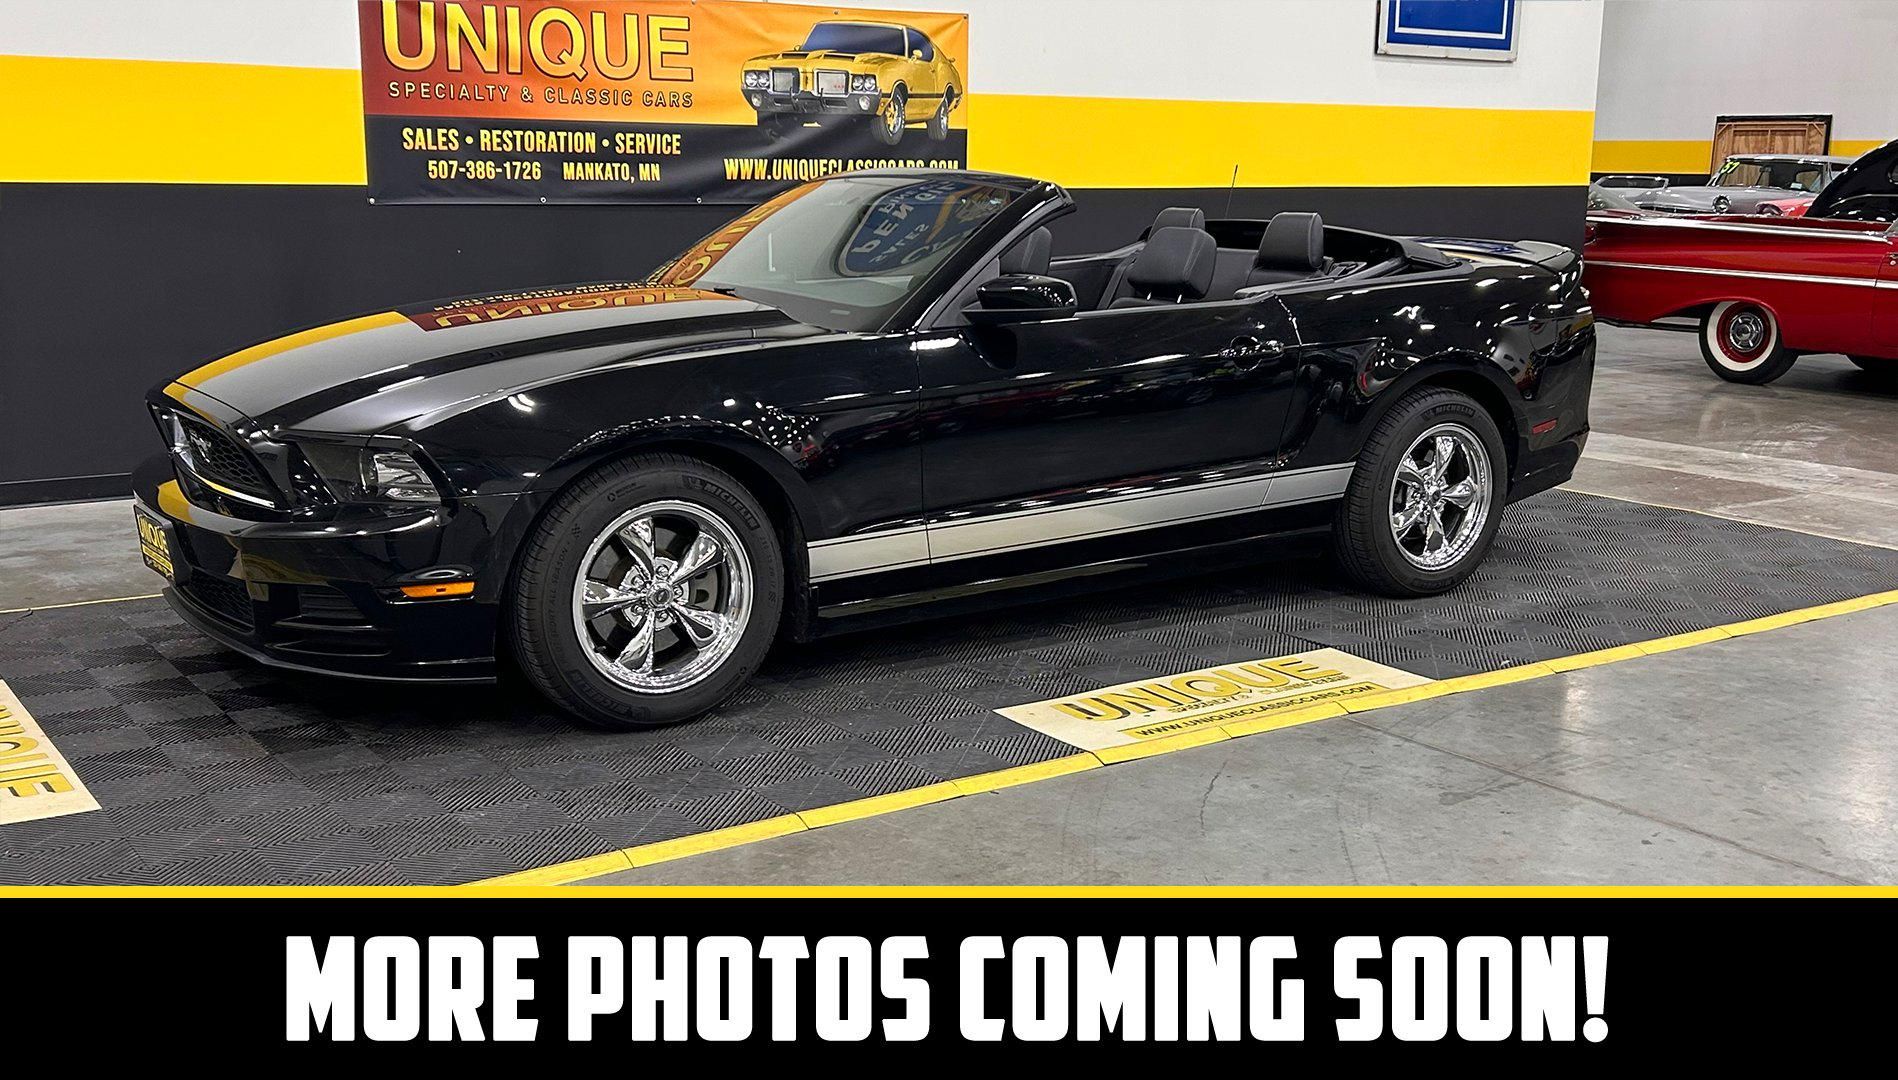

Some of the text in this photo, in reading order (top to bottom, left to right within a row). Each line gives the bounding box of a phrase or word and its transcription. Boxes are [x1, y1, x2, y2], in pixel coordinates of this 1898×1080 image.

[381, 0, 694, 81] UNIQUE
[388, 81, 693, 108] SPECIALTY & CLASSIC CARS
[402, 127, 682, 155] SALES RESTORATION SERVICE
[428, 160, 661, 184] 507-386-1726 MANKATO, MN
[723, 158, 959, 182] WWW.UNIQUECLAS
[1049, 657, 1343, 722] UNIQUE
